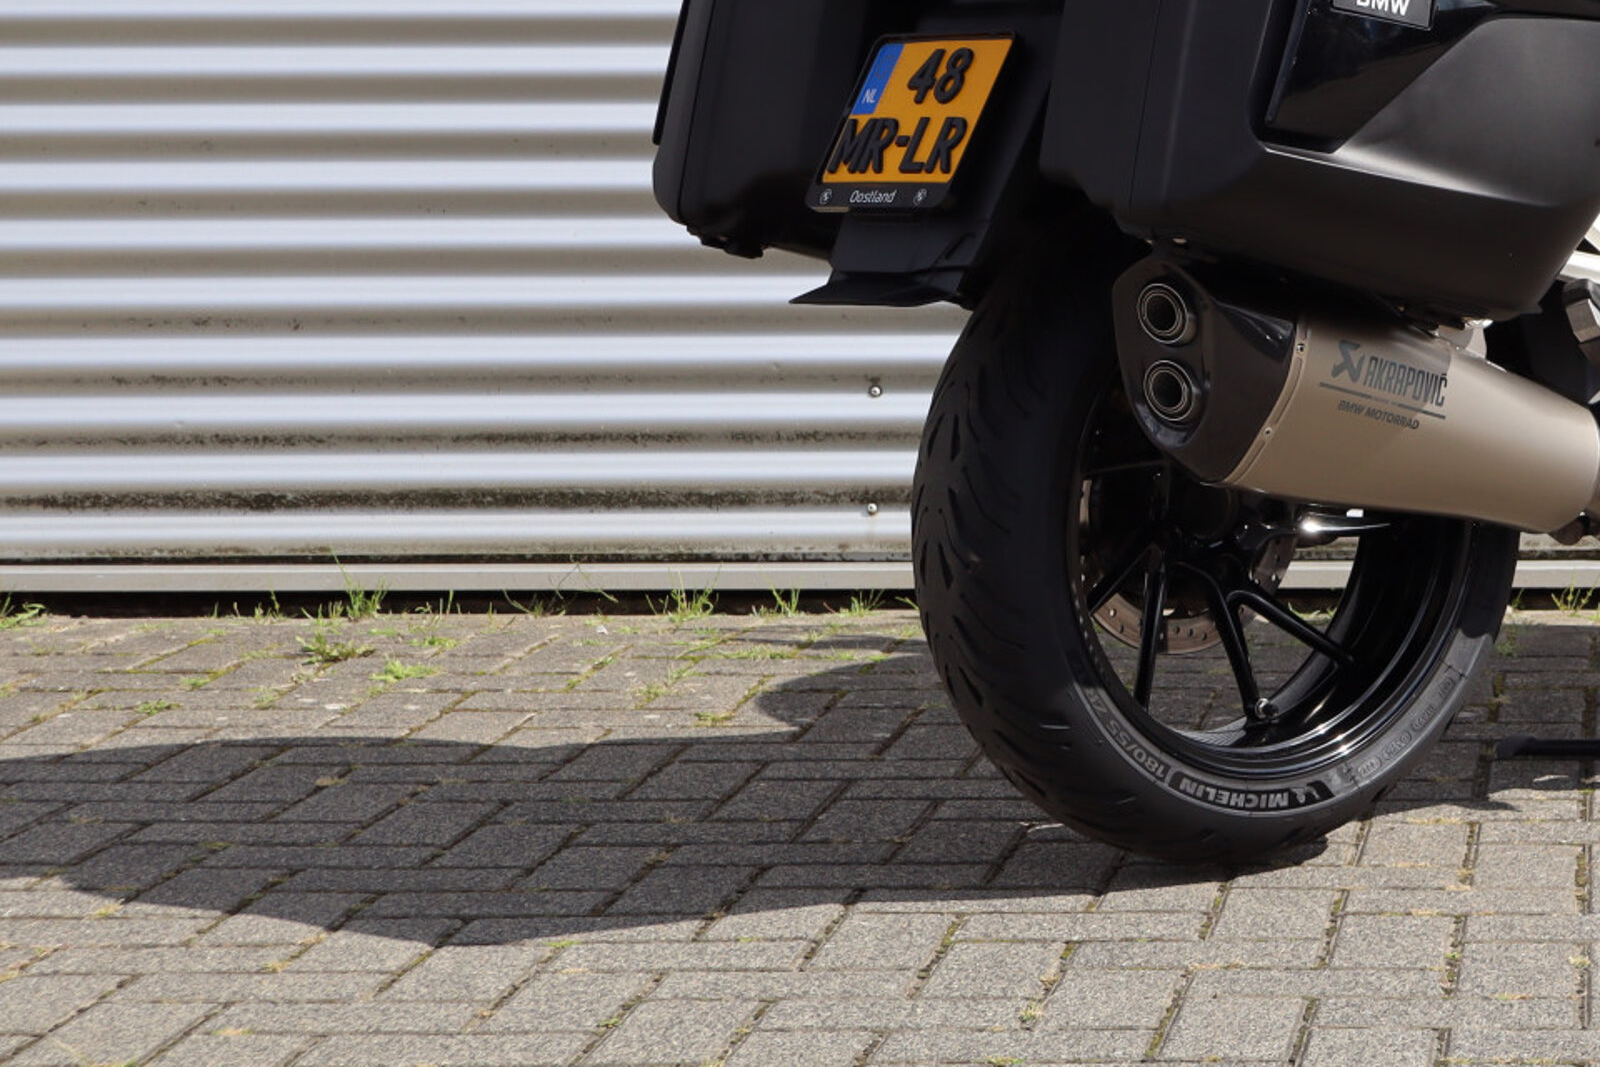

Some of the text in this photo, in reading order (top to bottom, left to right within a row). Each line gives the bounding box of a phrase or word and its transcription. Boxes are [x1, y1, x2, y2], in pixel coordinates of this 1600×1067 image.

[907, 47, 974, 104] 48
[861, 88, 878, 104] NL
[827, 116, 968, 174] MR-LR
[850, 190, 897, 203] Oostland
[1337, 399, 1420, 430] BMW MOTORRAD
[1105, 719, 1166, 779] 180/55
[1179, 777, 1289, 809] MICHELIN
